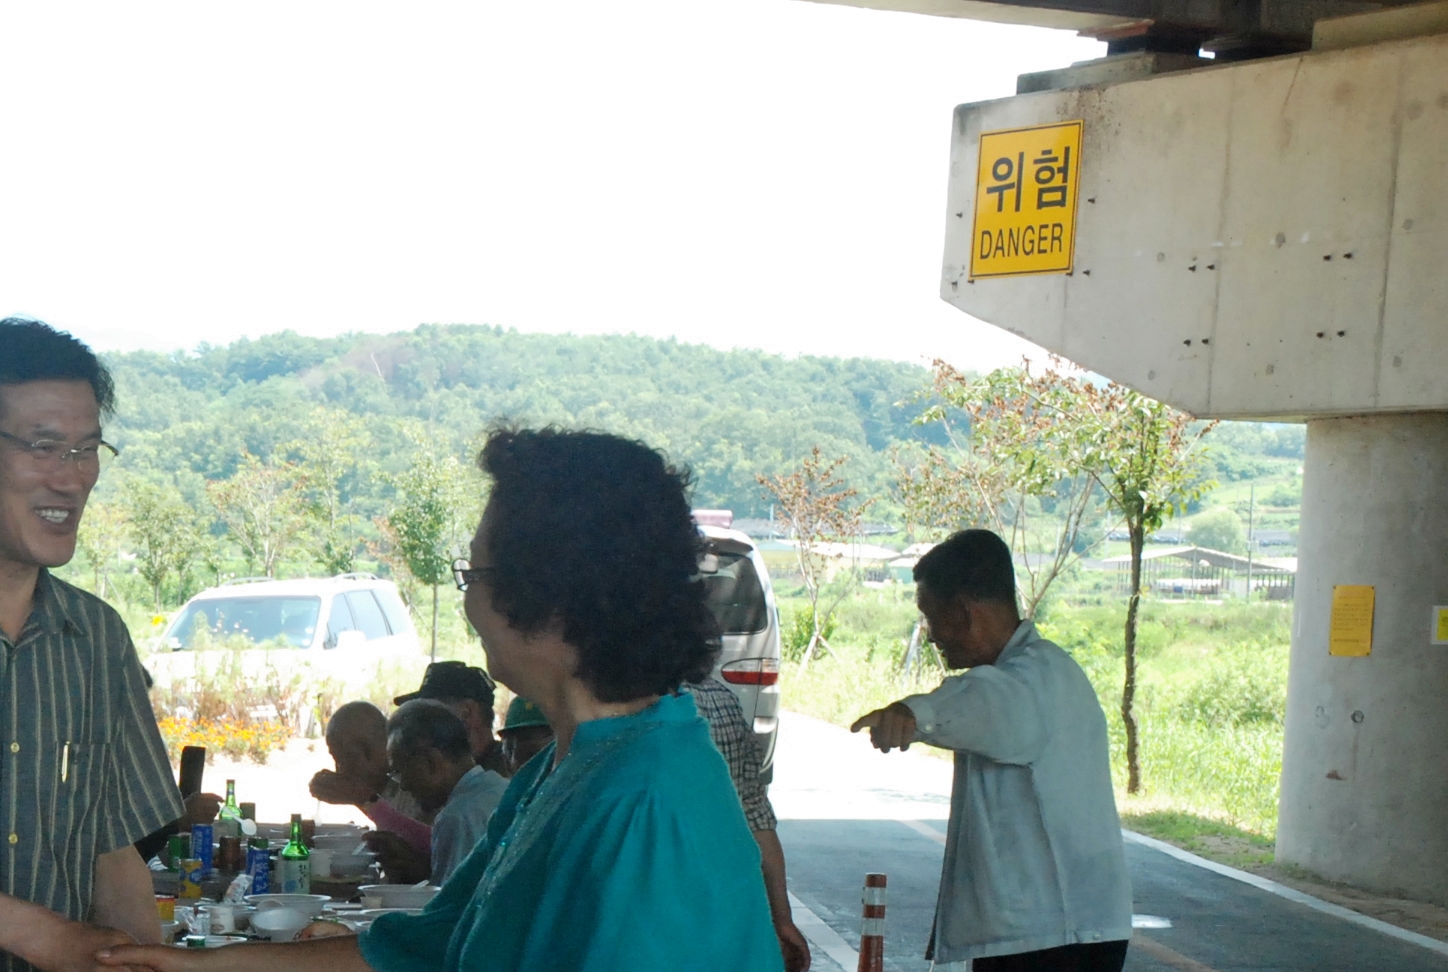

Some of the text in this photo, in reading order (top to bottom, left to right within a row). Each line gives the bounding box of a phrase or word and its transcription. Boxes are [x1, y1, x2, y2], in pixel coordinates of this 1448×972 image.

[986, 146, 1071, 213] 위험
[979, 222, 1064, 260] DANGER
[254, 853, 264, 893] SWEA
